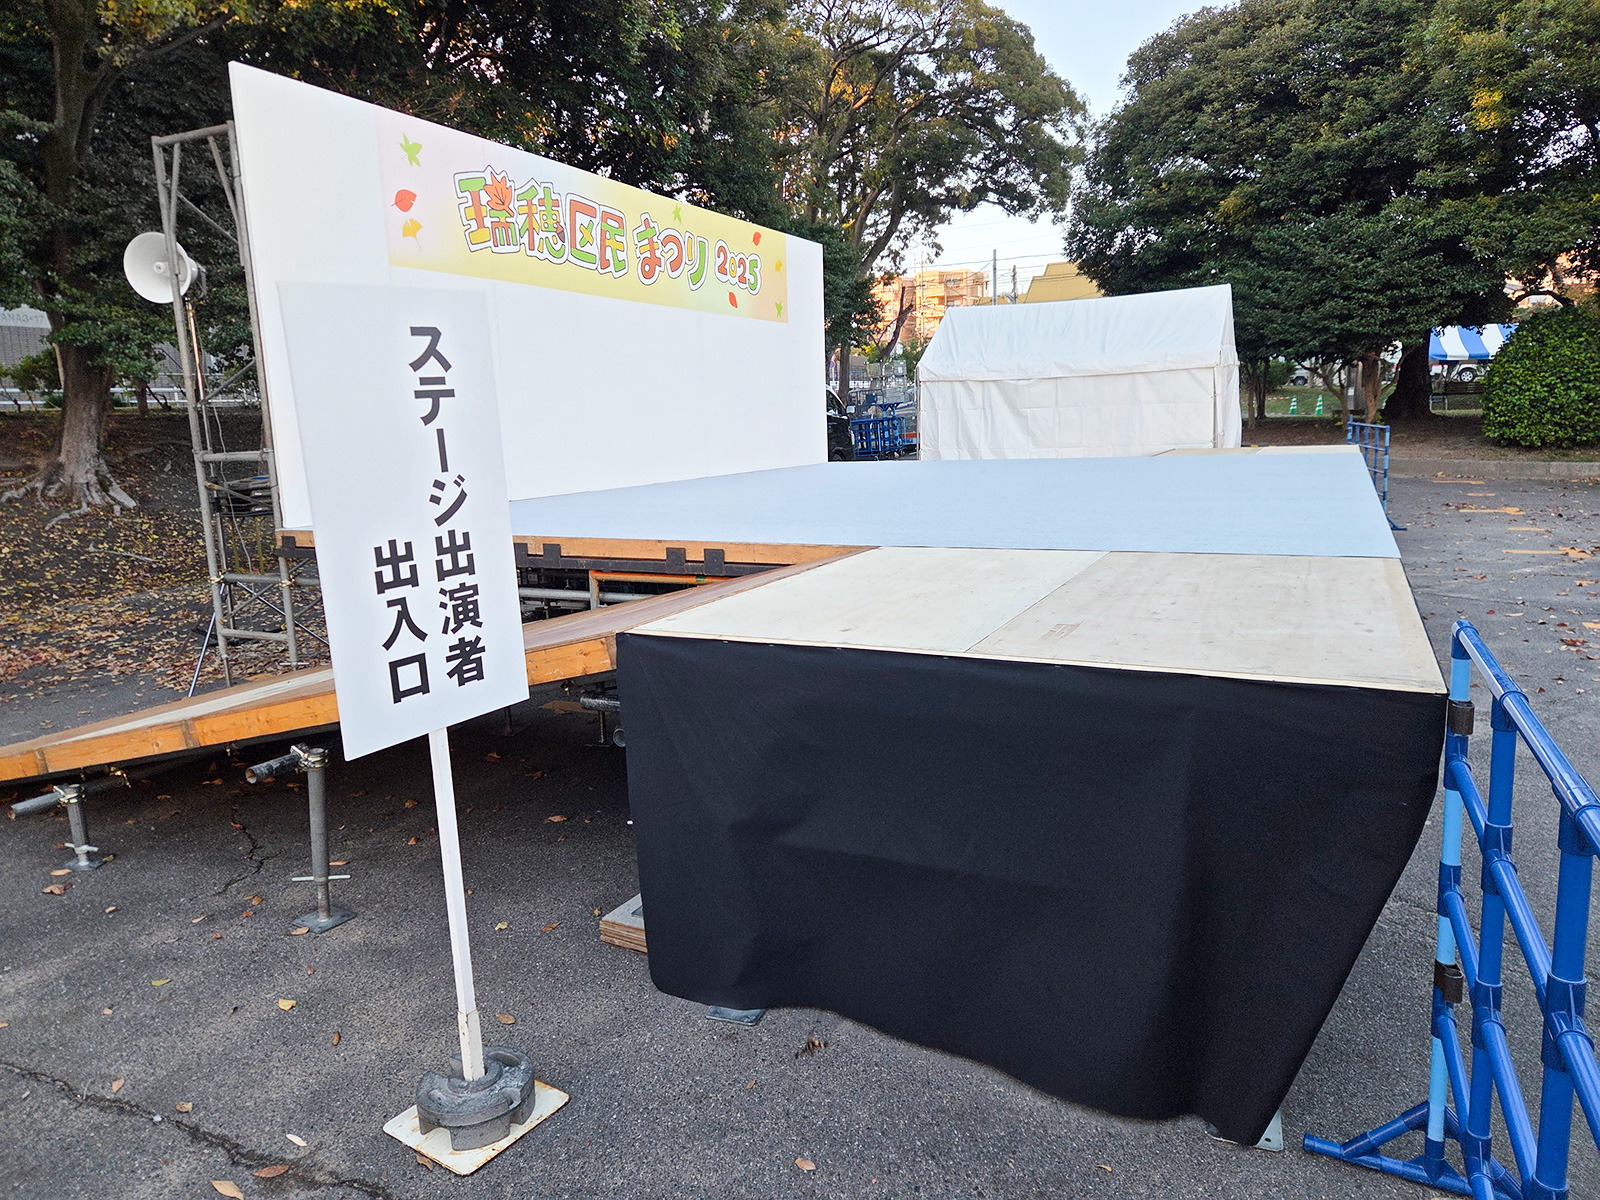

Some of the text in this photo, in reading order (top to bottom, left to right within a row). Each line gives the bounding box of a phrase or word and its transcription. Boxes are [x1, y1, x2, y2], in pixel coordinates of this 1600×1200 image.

[715, 241, 762, 295] 2025
[408, 326, 486, 687] ステージ出演者
[374, 539, 430, 704] 出入口
